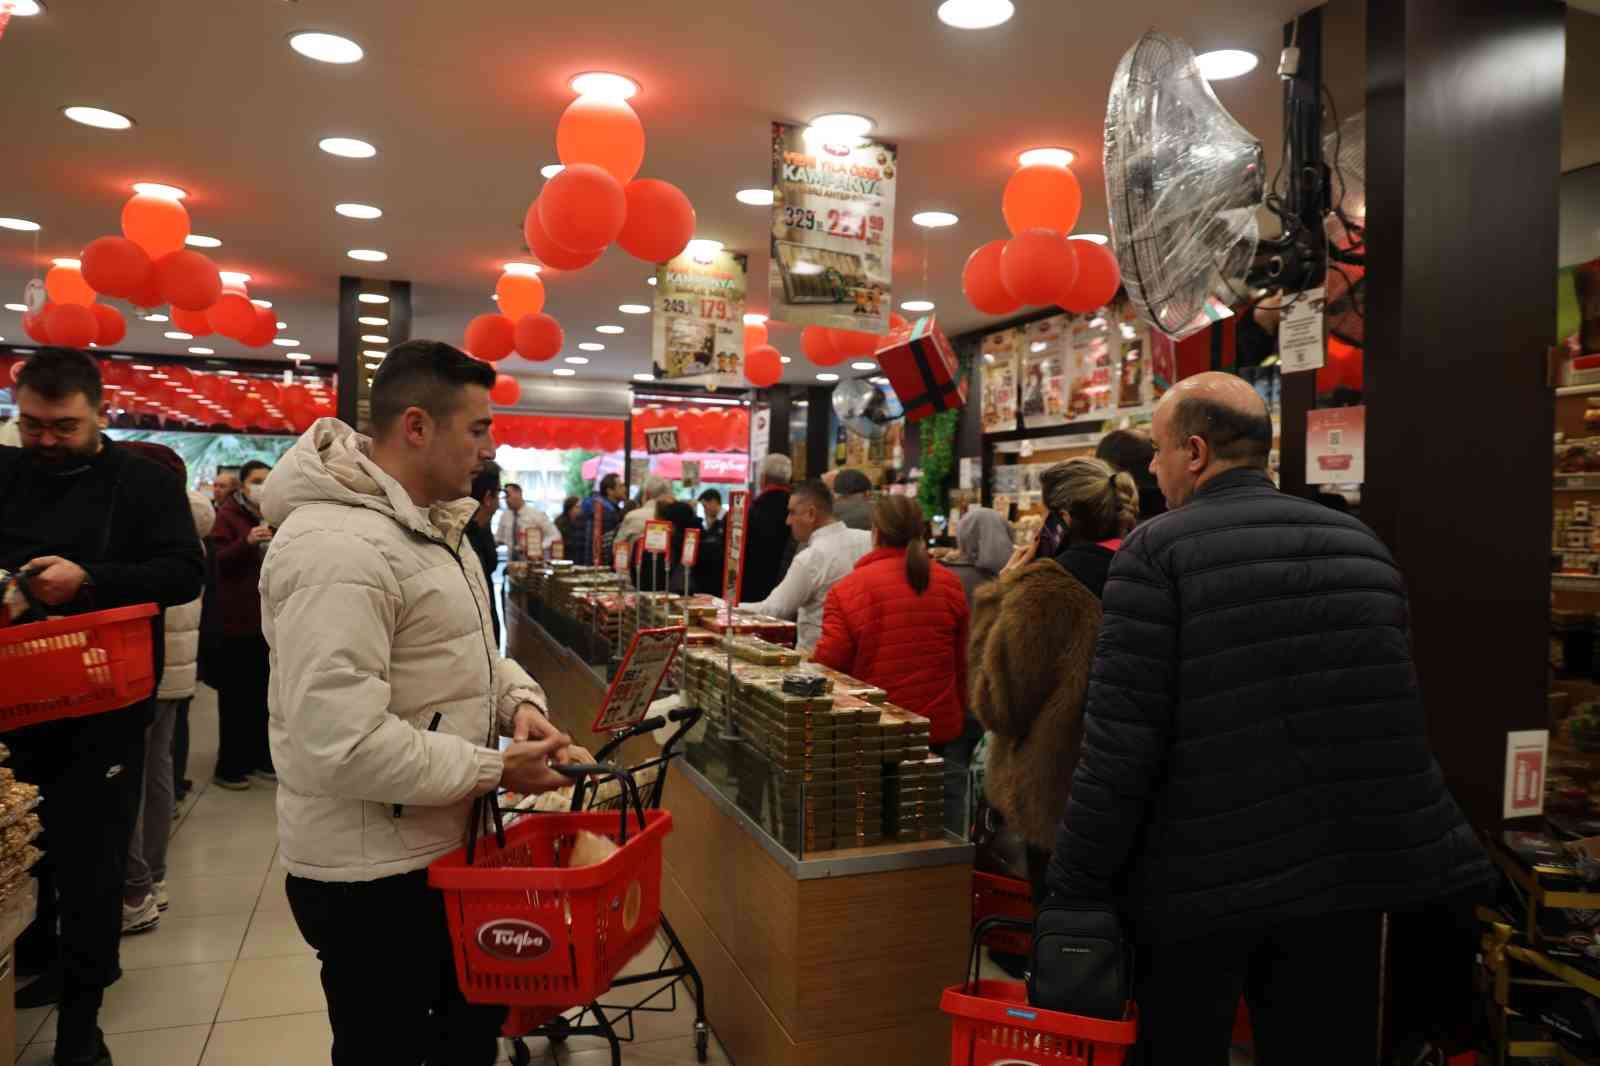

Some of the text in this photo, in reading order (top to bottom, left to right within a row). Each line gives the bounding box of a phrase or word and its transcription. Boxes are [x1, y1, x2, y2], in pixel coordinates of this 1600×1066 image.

[785, 206, 816, 230] 329
[701, 299, 726, 320] 179
[648, 432, 677, 452] KASA
